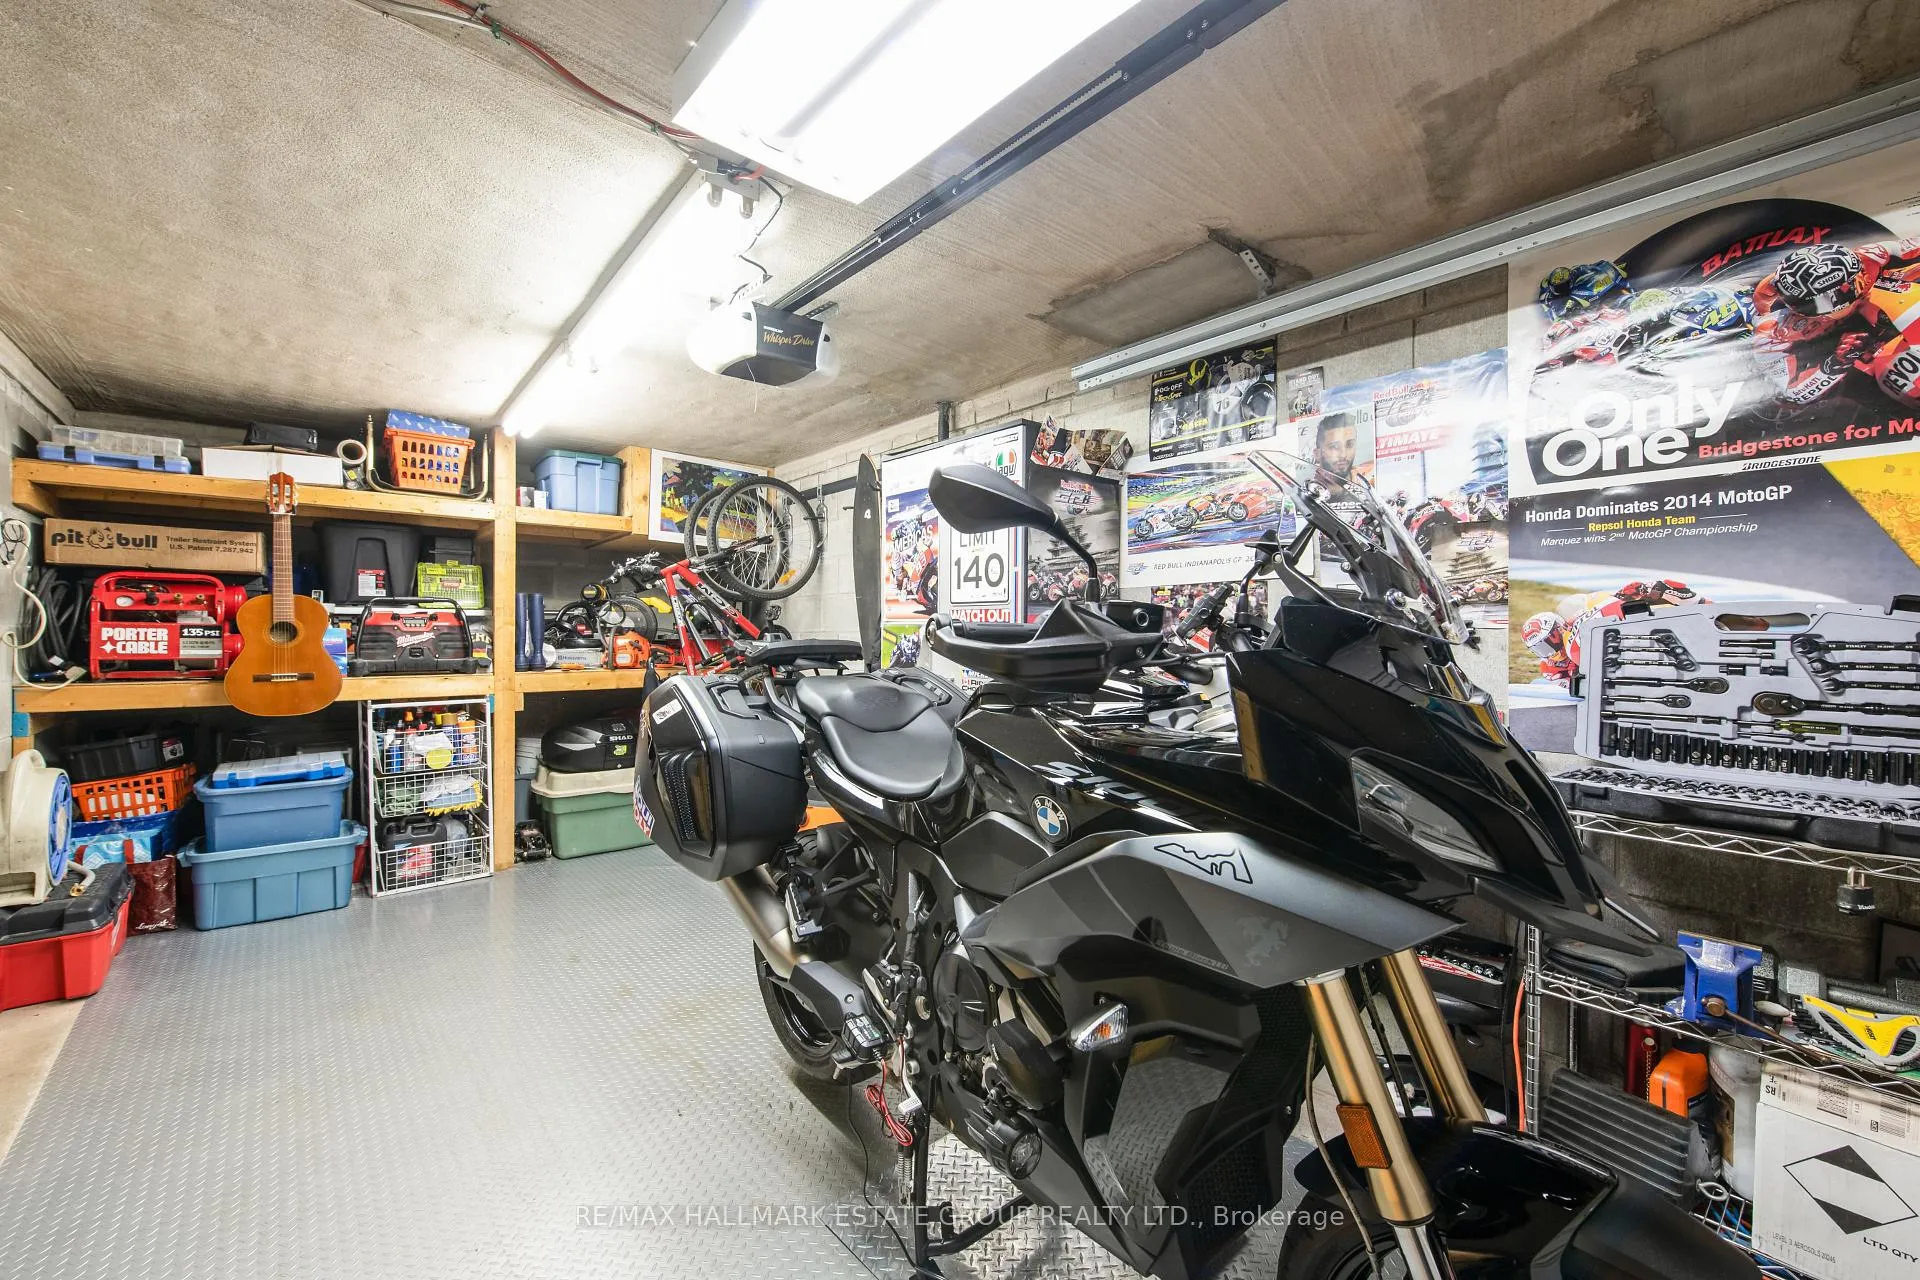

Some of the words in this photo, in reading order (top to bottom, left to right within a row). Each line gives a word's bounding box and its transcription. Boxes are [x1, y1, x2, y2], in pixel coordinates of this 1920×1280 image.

[1701, 226, 1831, 277] BATTLAX
[1818, 273, 1841, 287] SHOEI
[1569, 374, 1744, 438] Only
[1542, 428, 1689, 476] One
[1698, 430, 1839, 459] Bridgestone
[1844, 424, 1882, 440] for
[1742, 455, 1821, 471] BRIDGESTONE
[1525, 509, 1571, 523] Honda
[1576, 501, 1659, 519] Dominates
[1663, 493, 1712, 510] 2014
[1717, 485, 1793, 506] MotoGP
[1588, 519, 1624, 532] Repsol
[1626, 517, 1662, 529] Honda
[1665, 515, 1696, 526] Team
[51, 528, 84, 547] pit
[116, 533, 158, 549] bull
[166, 536, 191, 544] Trailer
[192, 537, 228, 545] Restraint
[229, 540, 257, 548] System
[1540, 536, 1582, 547] Marquez
[1583, 534, 1606, 544] wins
[1609, 531, 1626, 542] 2nd
[1628, 528, 1672, 541] MotoGP
[1674, 522, 1758, 537] Championship
[954, 552, 1005, 590] 140
[1154, 563, 1166, 571] RED
[1185, 557, 1231, 568] INDIANAPOLIS
[950, 609, 983, 623] WATCH
[986, 608, 1011, 623] OUT
[101, 627, 168, 641] PORTER
[182, 628, 204, 637] 135
[116, 641, 168, 654] CABLE
[1034, 798, 1065, 821] BMW
[1863, 1237, 1888, 1251] LTD
[1892, 1249, 1919, 1263] QTY
